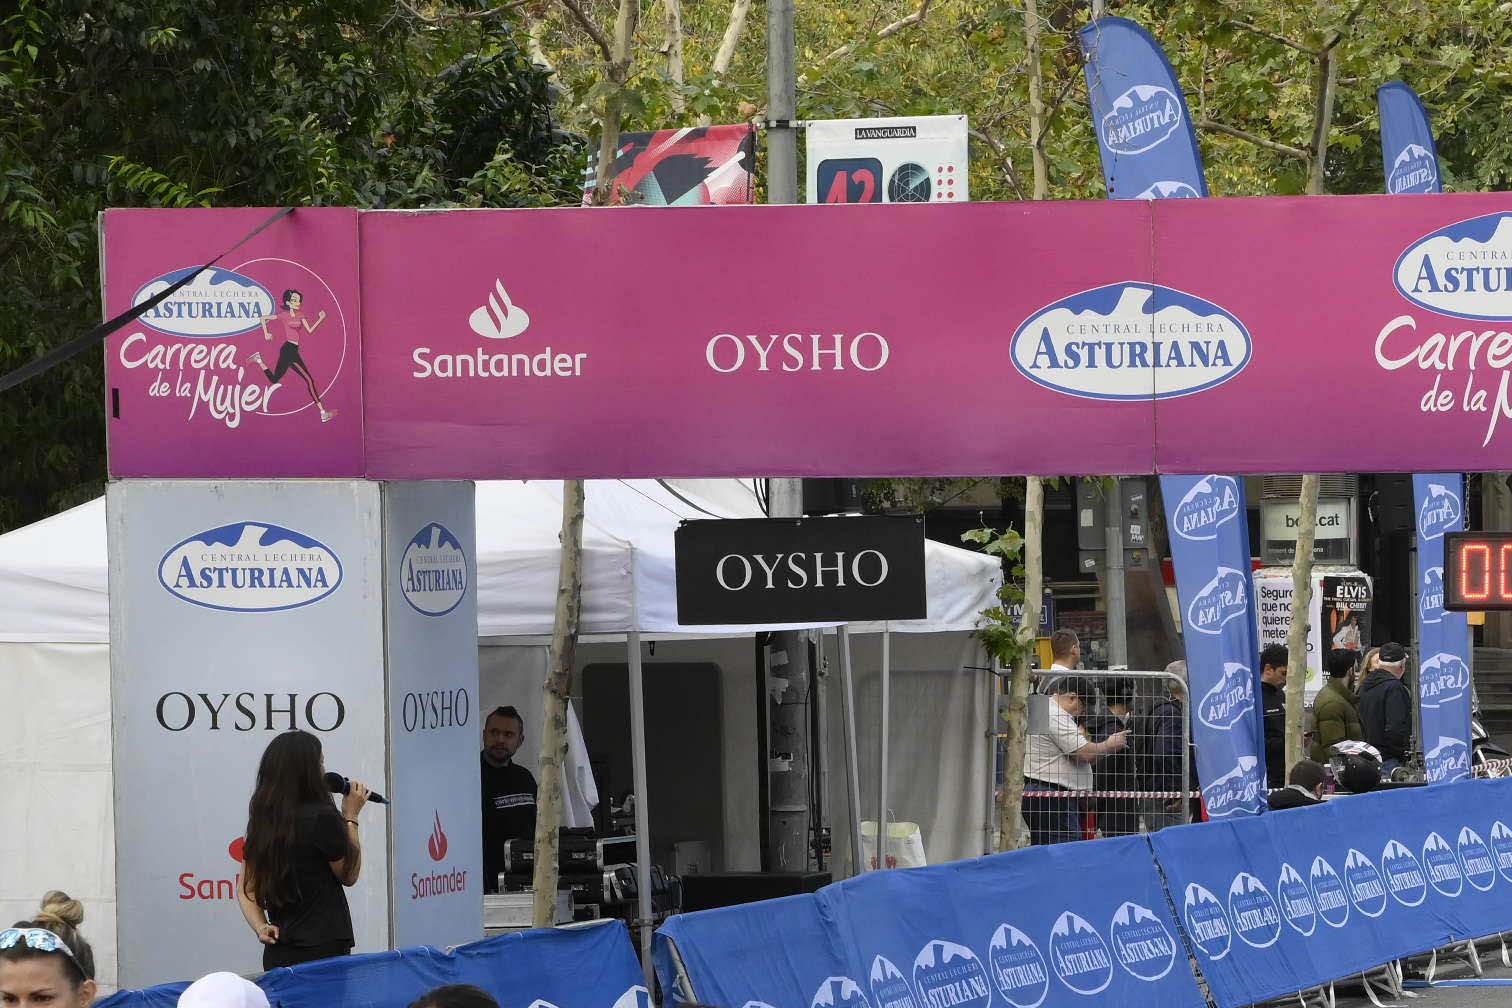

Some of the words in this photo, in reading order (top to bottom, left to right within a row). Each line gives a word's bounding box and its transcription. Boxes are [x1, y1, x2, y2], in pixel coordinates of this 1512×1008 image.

[142, 292, 264, 319] ASTURIANA
[166, 290, 209, 298] ENTRAL
[1066, 323, 1141, 335] CENTRAL
[120, 333, 237, 370] Carrera
[413, 346, 587, 379] Santander
[705, 332, 889, 373] OYSHO
[1029, 325, 1231, 370] ASTURIANA
[149, 371, 171, 397] de
[176, 375, 192, 397] la
[189, 366, 282, 428] Mujer
[1421, 375, 1454, 412] de
[1463, 373, 1488, 412] la
[173, 554, 329, 589] ASTURIANA
[201, 553, 259, 562] CENTRAL
[265, 552, 323, 562] LECHERA
[715, 549, 889, 591] OYSHO
[406, 562, 463, 594] ASTURIANA
[1337, 586, 1366, 598] ELVIS
[155, 691, 345, 732] OYSHO
[403, 688, 469, 732] OYSHO
[411, 867, 467, 901] Santander
[994, 959, 1046, 991] ASTURIANA
[1056, 945, 1110, 977] ASTURIANA
